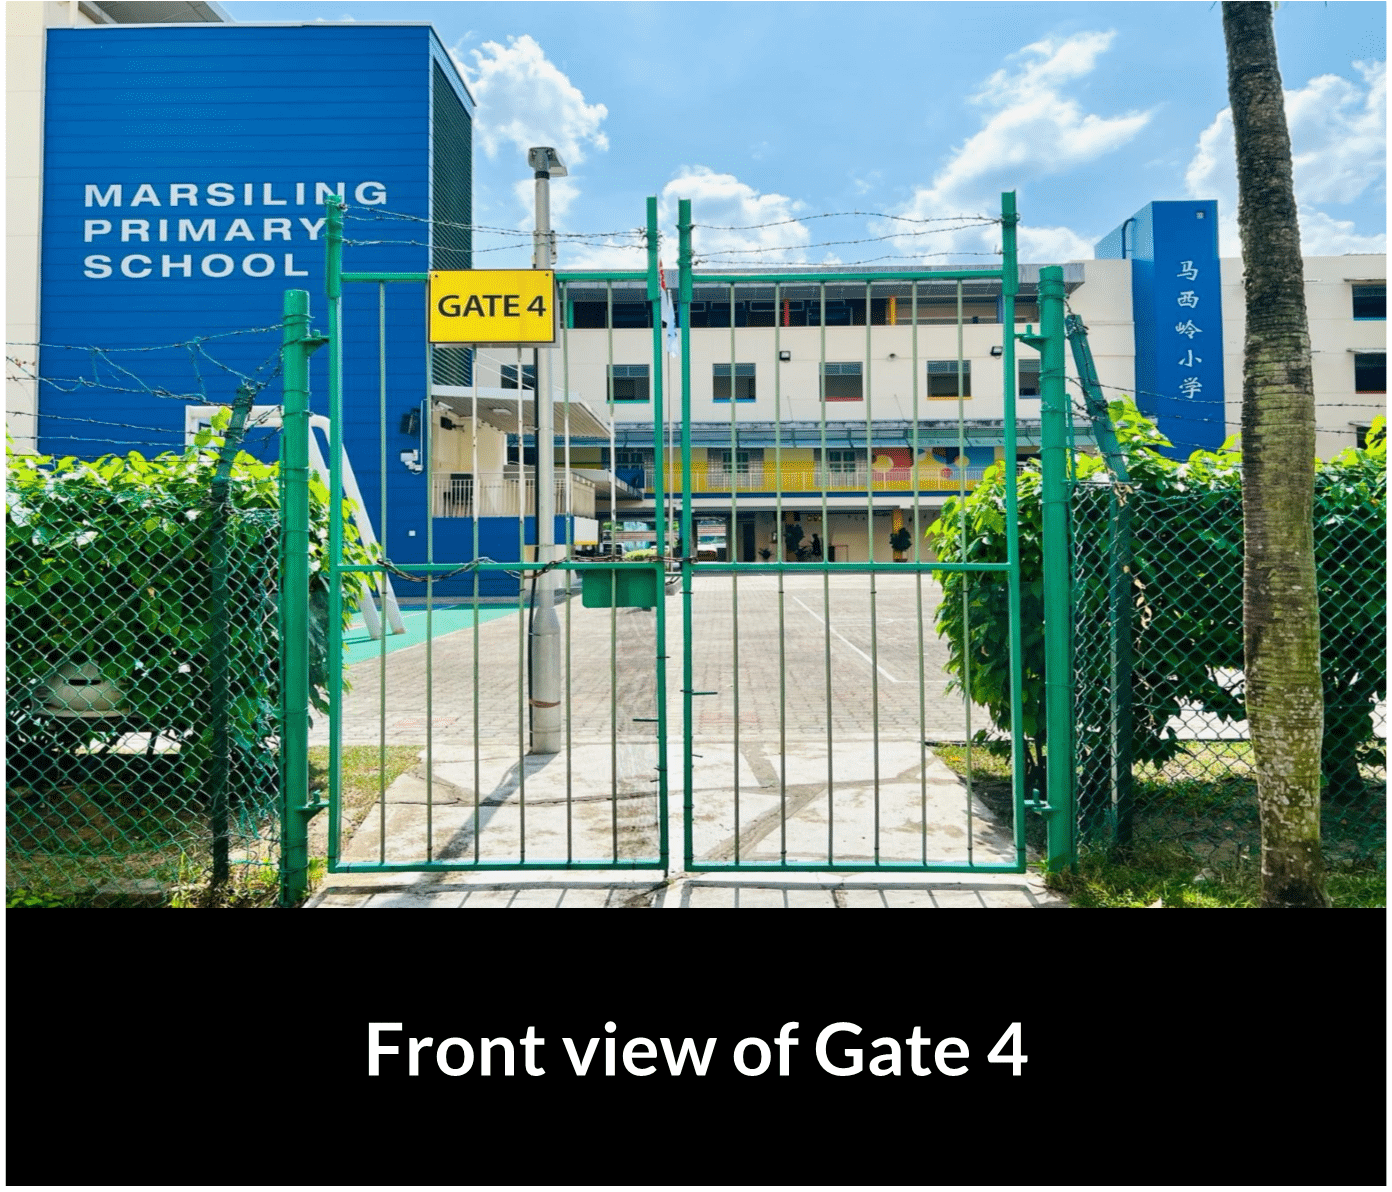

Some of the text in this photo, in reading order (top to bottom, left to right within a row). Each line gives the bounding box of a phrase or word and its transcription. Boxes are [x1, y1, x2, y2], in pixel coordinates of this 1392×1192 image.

[84, 181, 387, 207] MARSILING
[83, 217, 328, 243] PRIMARY
[82, 253, 309, 279] SCHOOL
[437, 294, 547, 318] GATE 4
[1175, 260, 1204, 399] 马西岭小学
